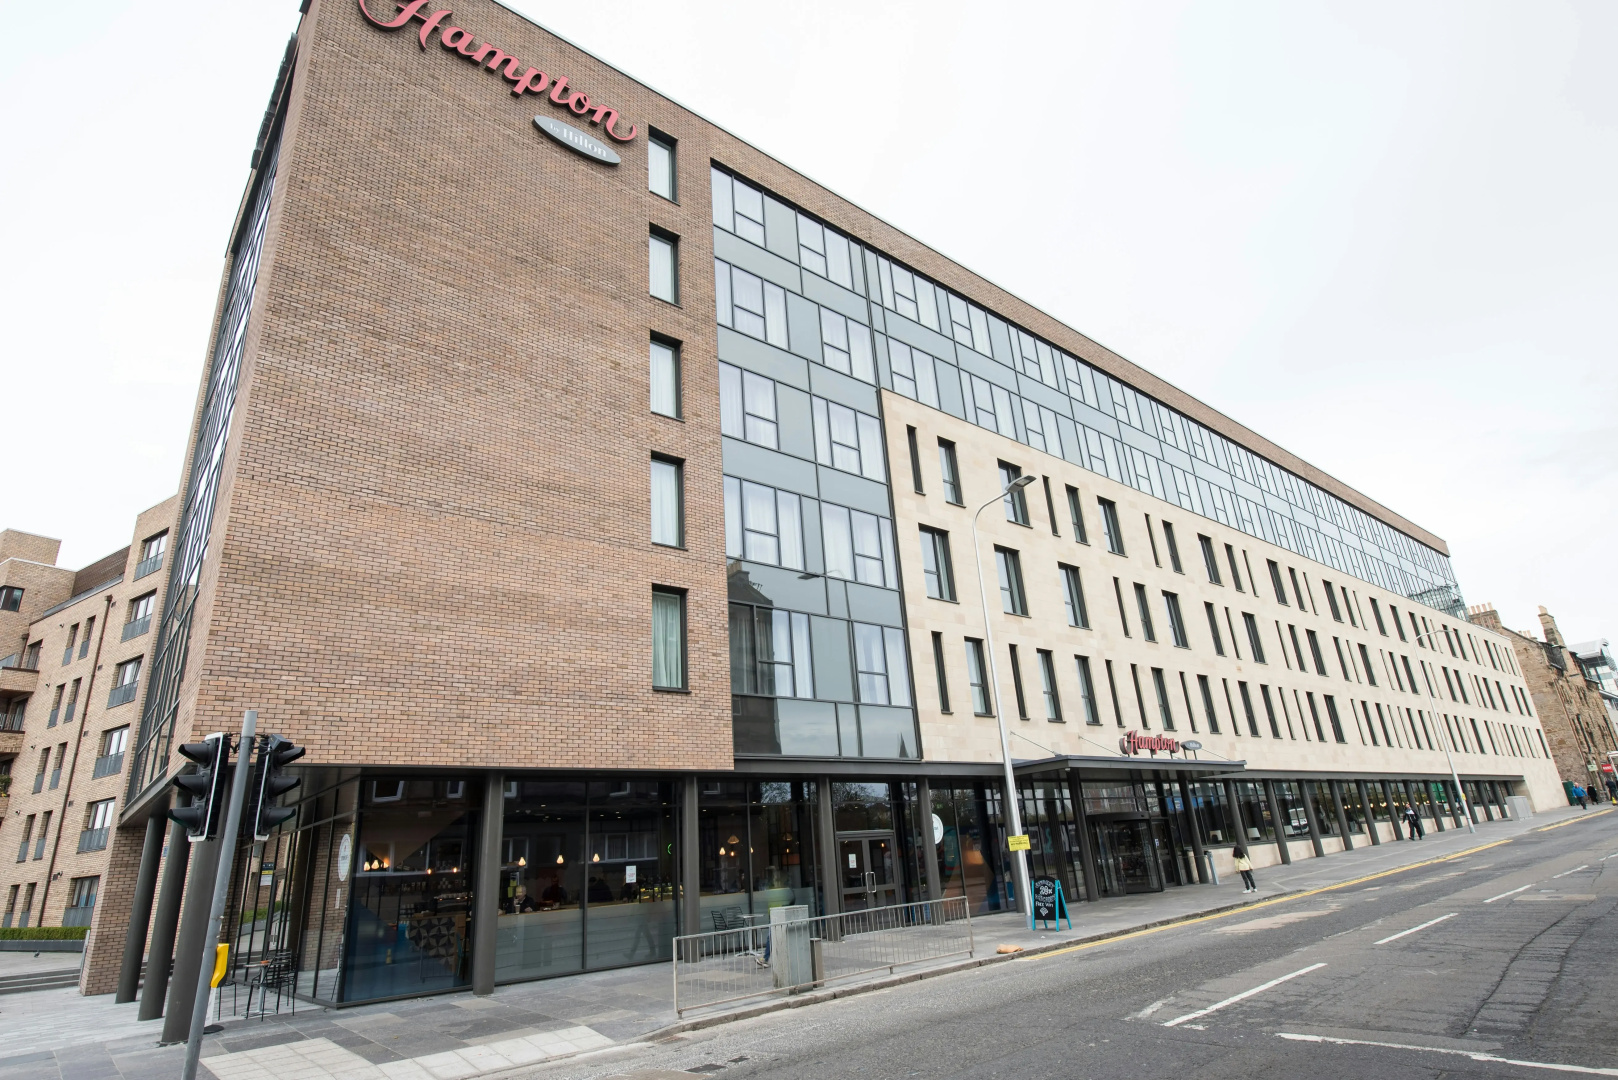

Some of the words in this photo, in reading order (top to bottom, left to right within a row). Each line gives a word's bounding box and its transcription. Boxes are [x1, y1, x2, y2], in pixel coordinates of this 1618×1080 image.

[358, 0, 638, 143] Hampton
[550, 123, 560, 134] by
[563, 128, 607, 157] Hilton
[1120, 730, 1180, 755] Hampton
